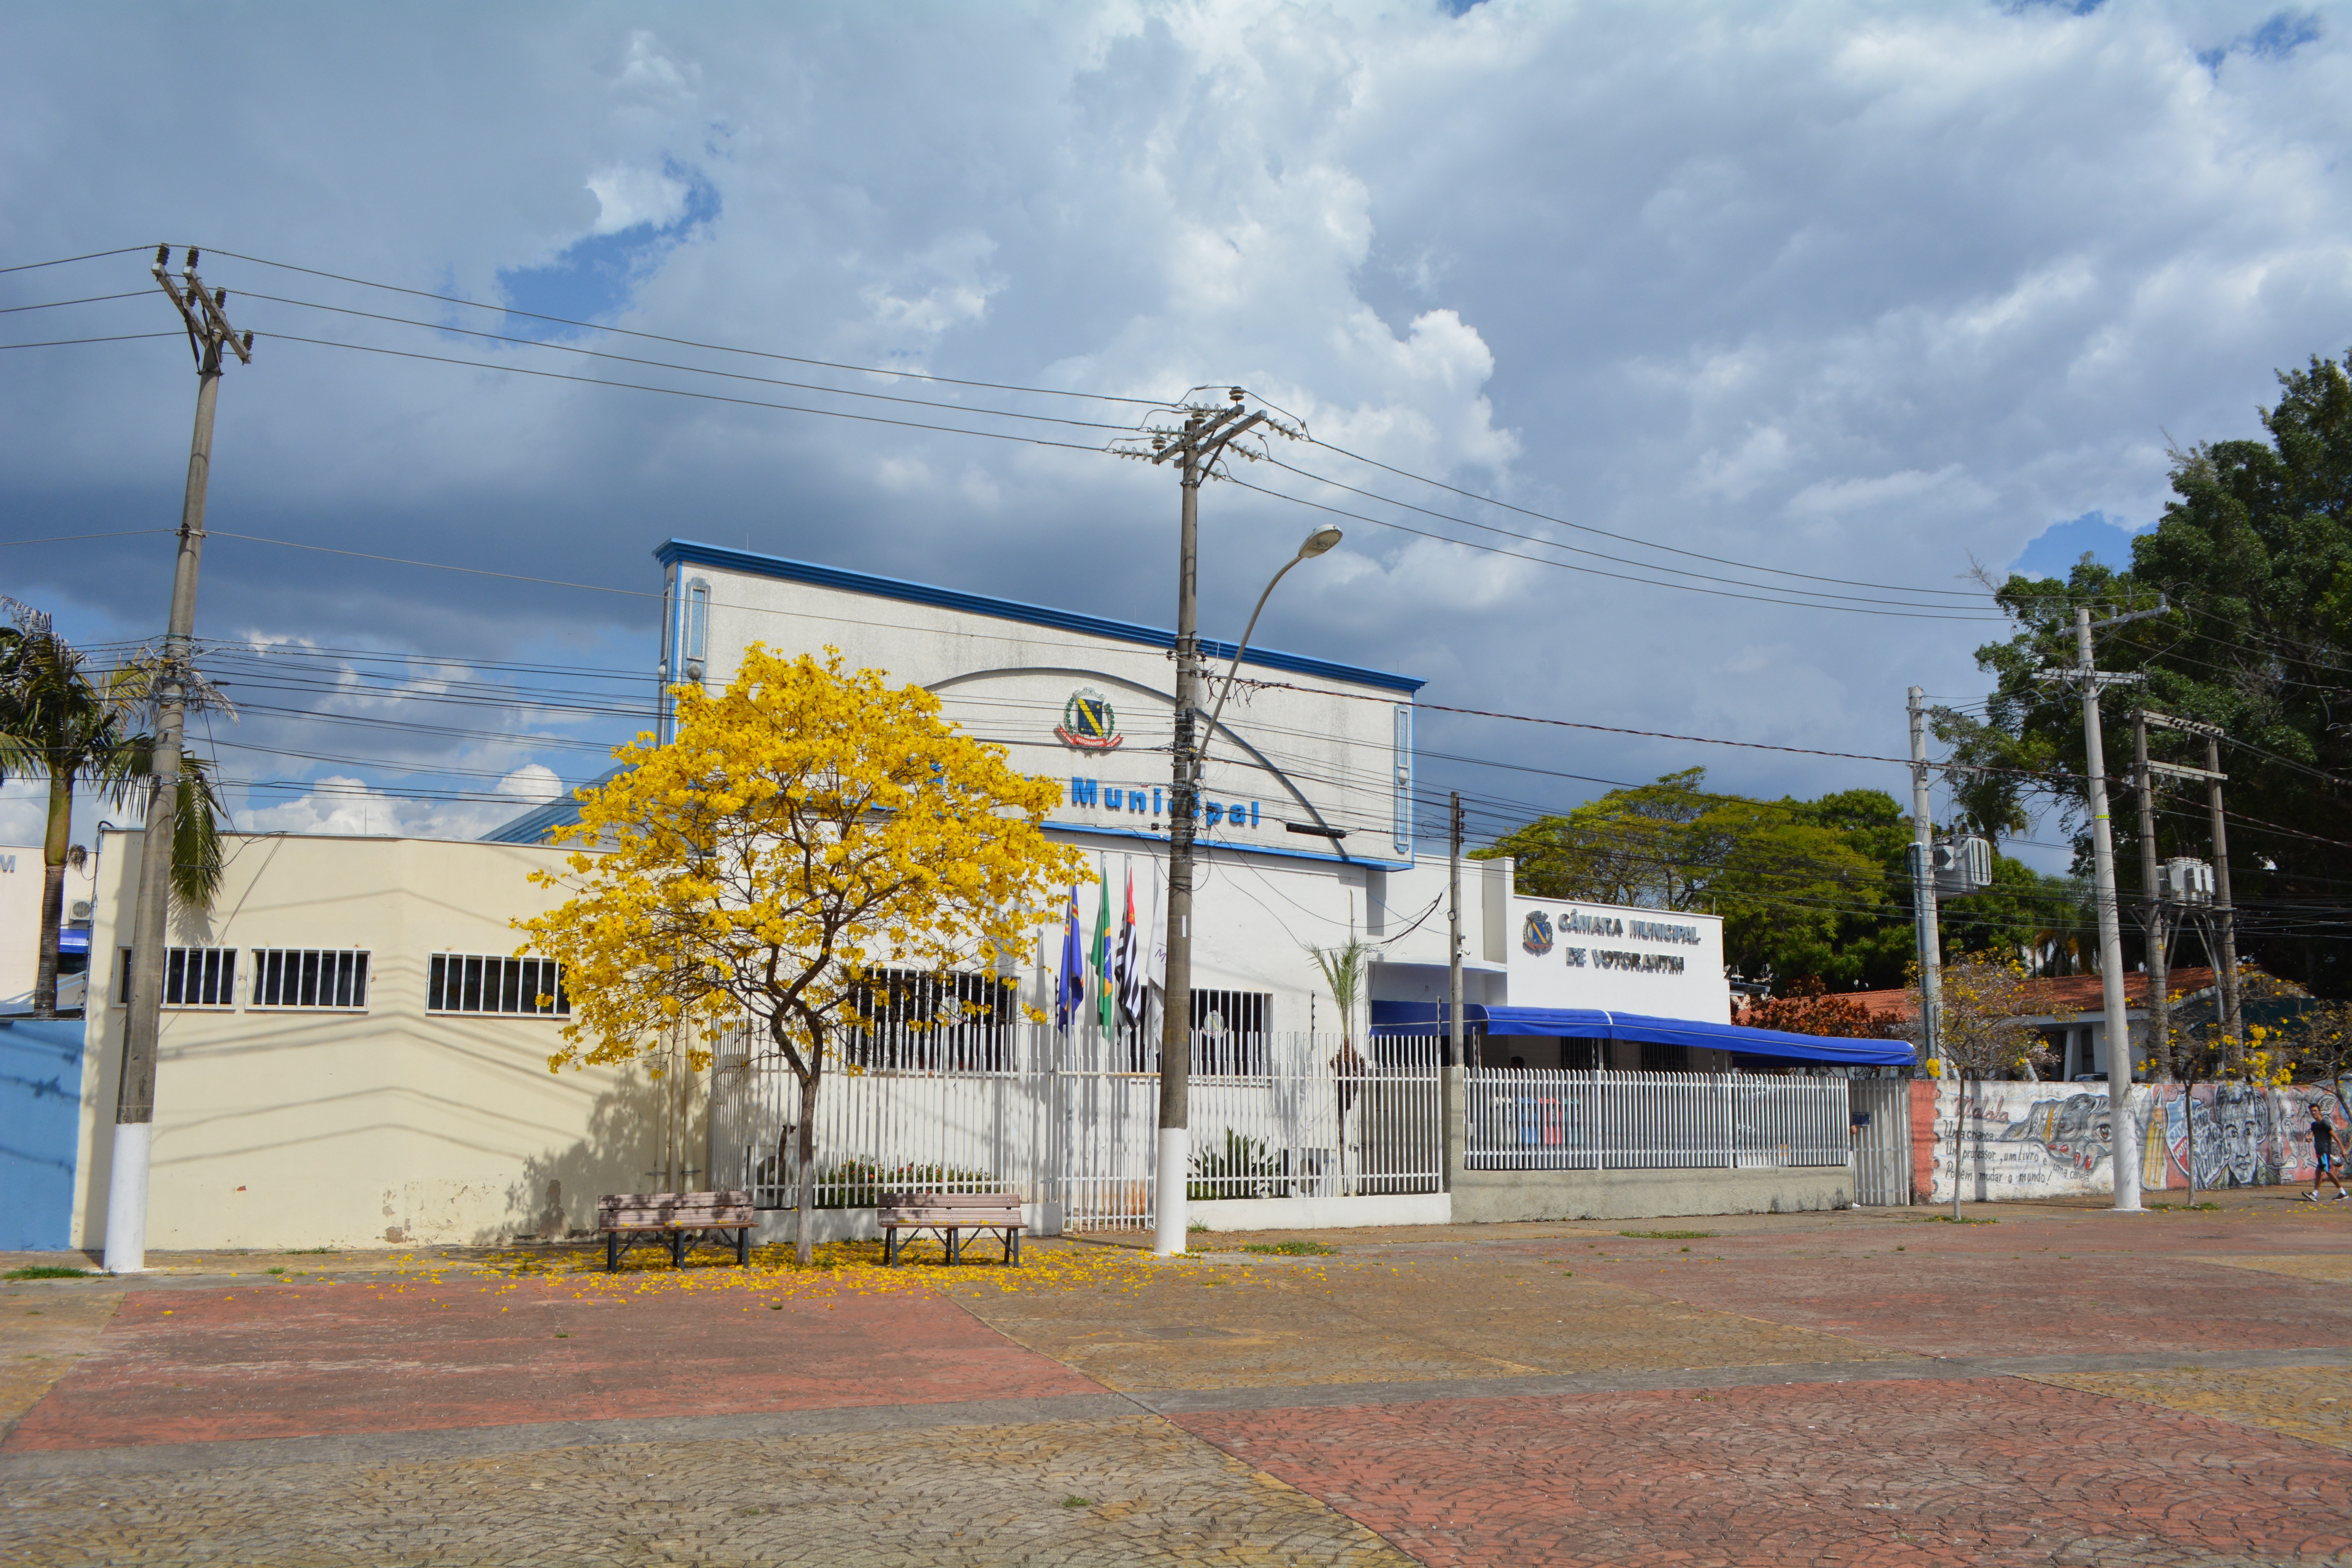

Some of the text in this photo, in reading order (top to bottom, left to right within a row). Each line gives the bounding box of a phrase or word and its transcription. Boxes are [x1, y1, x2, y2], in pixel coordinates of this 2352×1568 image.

[1076, 737, 1104, 746] VOTORANTIM
[1072, 777, 1259, 826] Muniipal
[1558, 908, 1701, 941] CÂMARA MUNICIPAL
[1566, 947, 1684, 971] DE VOTORANTIM
[1945, 1160, 1973, 1181] Poem
[1979, 1167, 2003, 1183] mudar
[2053, 1163, 2068, 1178] uma
